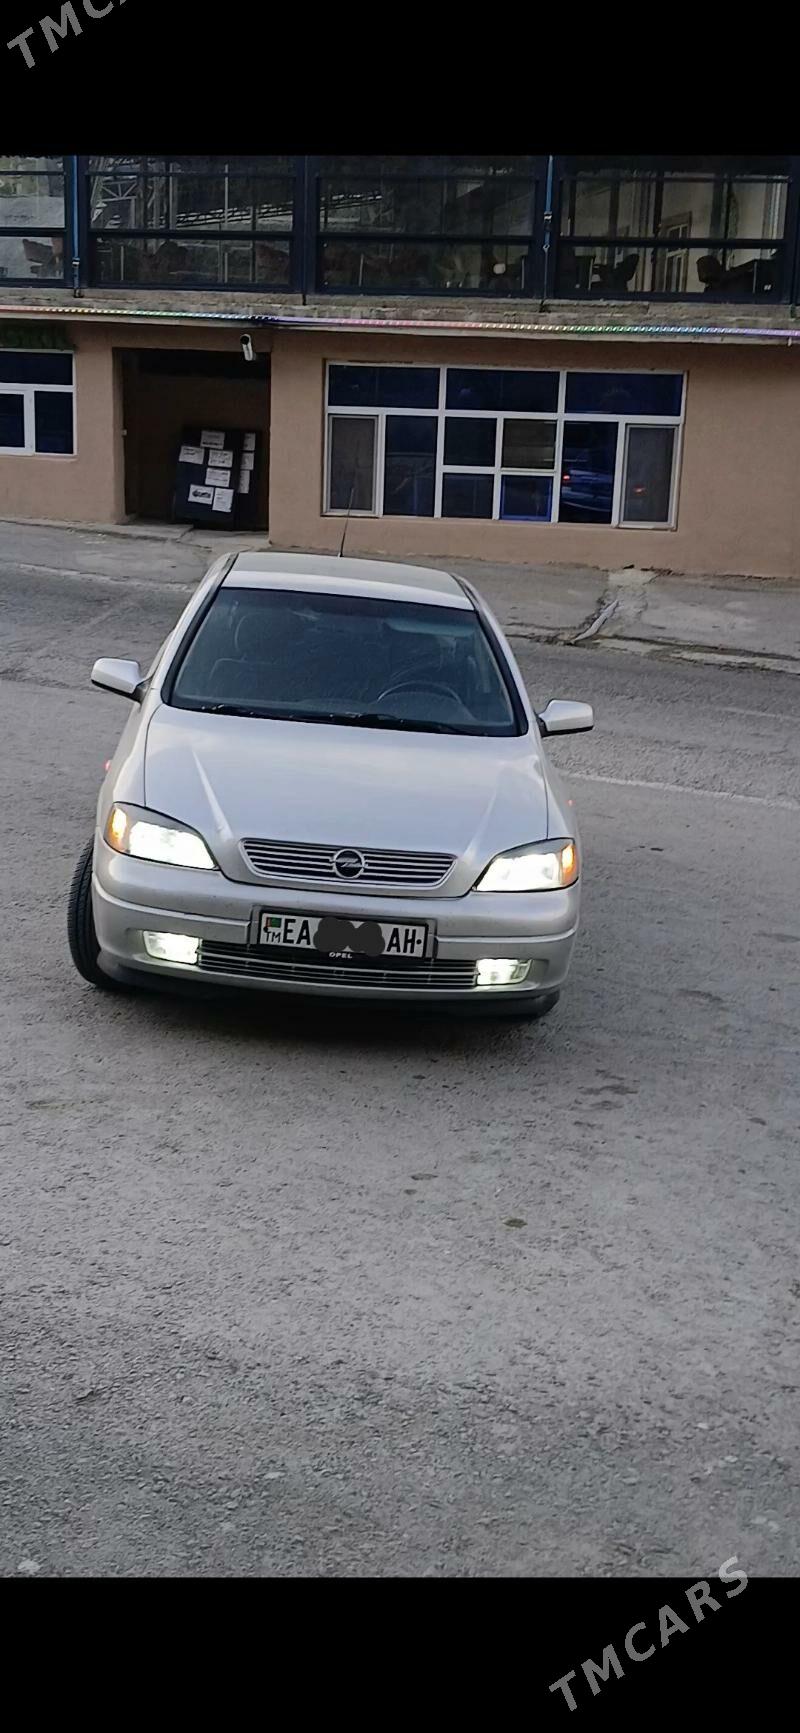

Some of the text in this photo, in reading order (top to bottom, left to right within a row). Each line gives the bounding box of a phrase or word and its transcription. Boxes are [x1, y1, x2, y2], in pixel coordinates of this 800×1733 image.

[265, 931, 281, 943] TM
[283, 918, 417, 954] EA AH
[328, 951, 353, 959] OPEL
